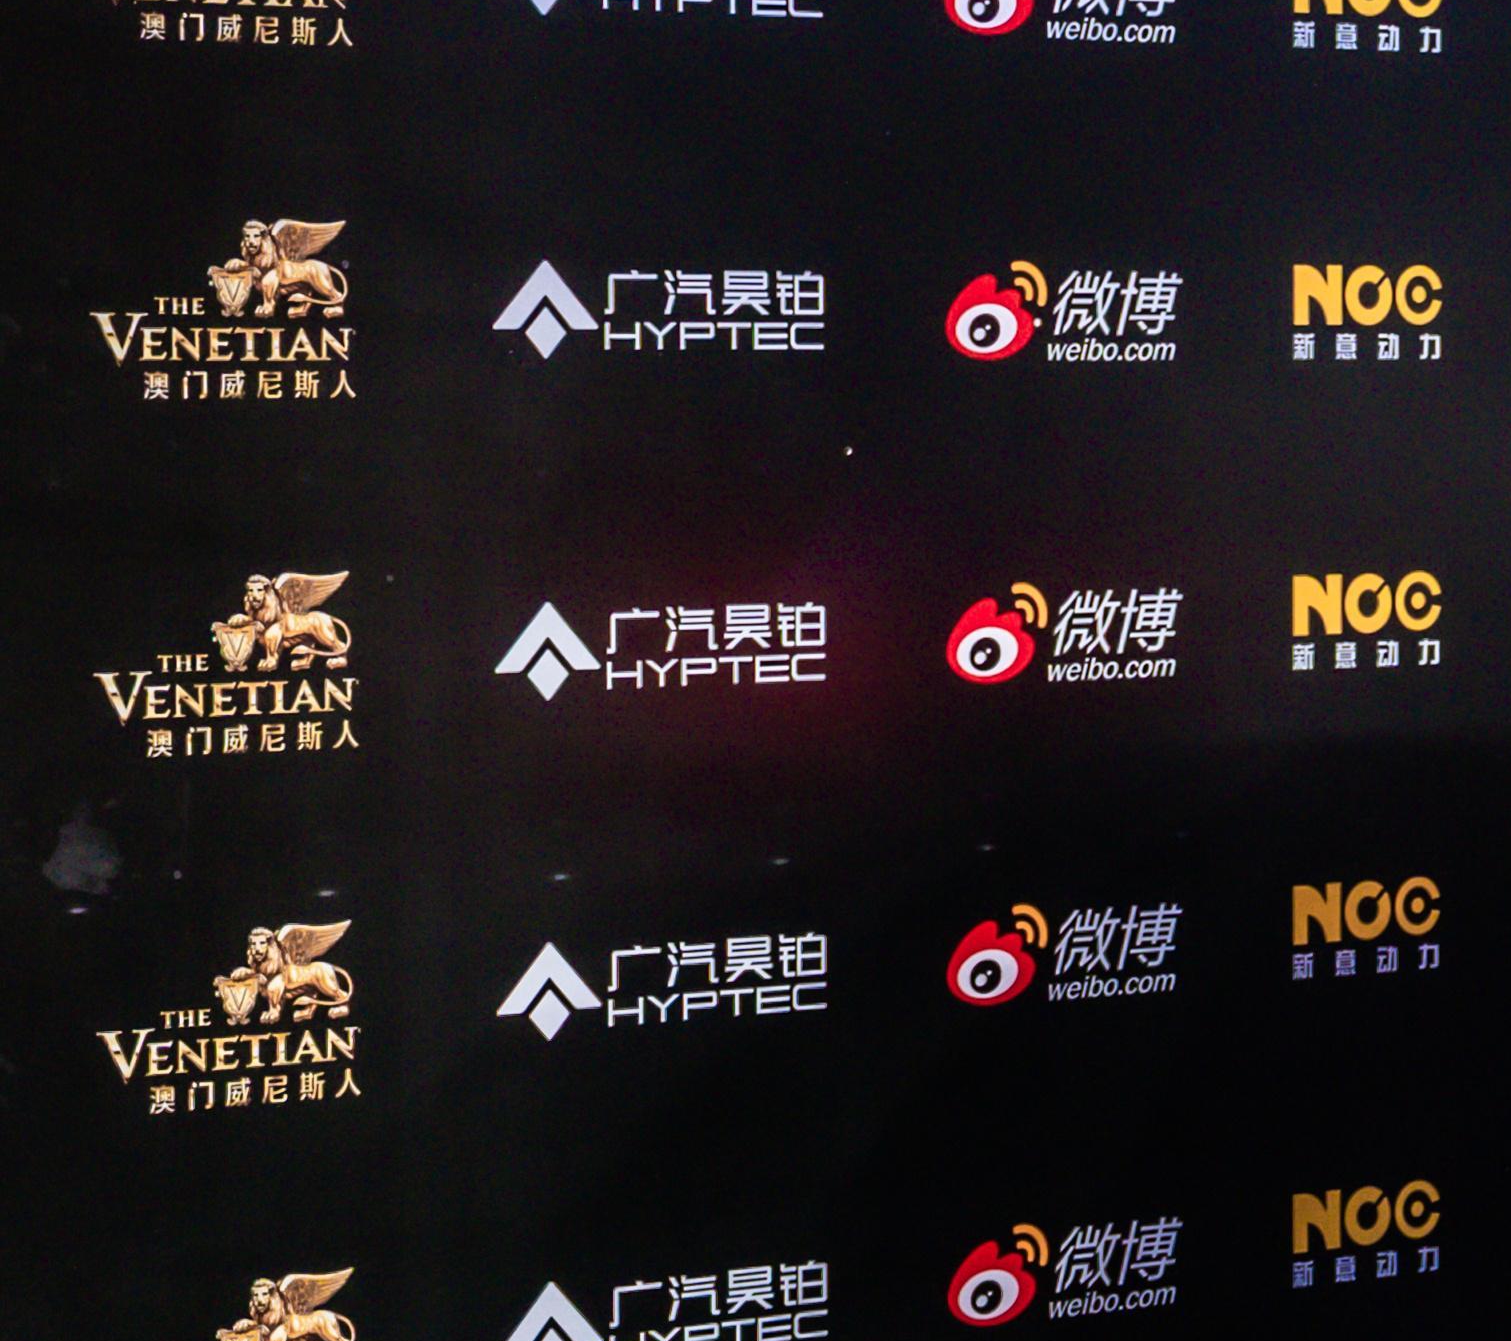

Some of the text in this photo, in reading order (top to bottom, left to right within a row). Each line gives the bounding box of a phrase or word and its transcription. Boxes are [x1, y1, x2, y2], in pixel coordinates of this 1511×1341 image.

[141, 13, 352, 46] 澳门威尼斯人
[1047, 17, 1175, 43] weibo.com
[1294, 21, 1441, 53] 新意动力
[604, 270, 824, 315] 广汽昊铂
[1293, 265, 1442, 325] NOC
[90, 308, 352, 364] VENETIAN
[1048, 338, 1176, 361] weibo.com
[1292, 571, 1441, 636] NOC
[606, 602, 825, 654] 广汽昊铂
[1054, 588, 1183, 662] 微博
[157, 654, 208, 672] THE
[606, 653, 826, 690] HYPTEC
[1048, 657, 1176, 681] weibo.com
[1293, 638, 1440, 670] 新意动力
[93, 671, 358, 725] VENETIAN
[147, 720, 359, 757] 澳门威尼斯人
[1055, 903, 1182, 980] 微博
[608, 982, 827, 1027] HYPTEC
[1056, 1217, 1183, 1299] 微博
[1049, 1285, 1176, 1318] weibo.com
